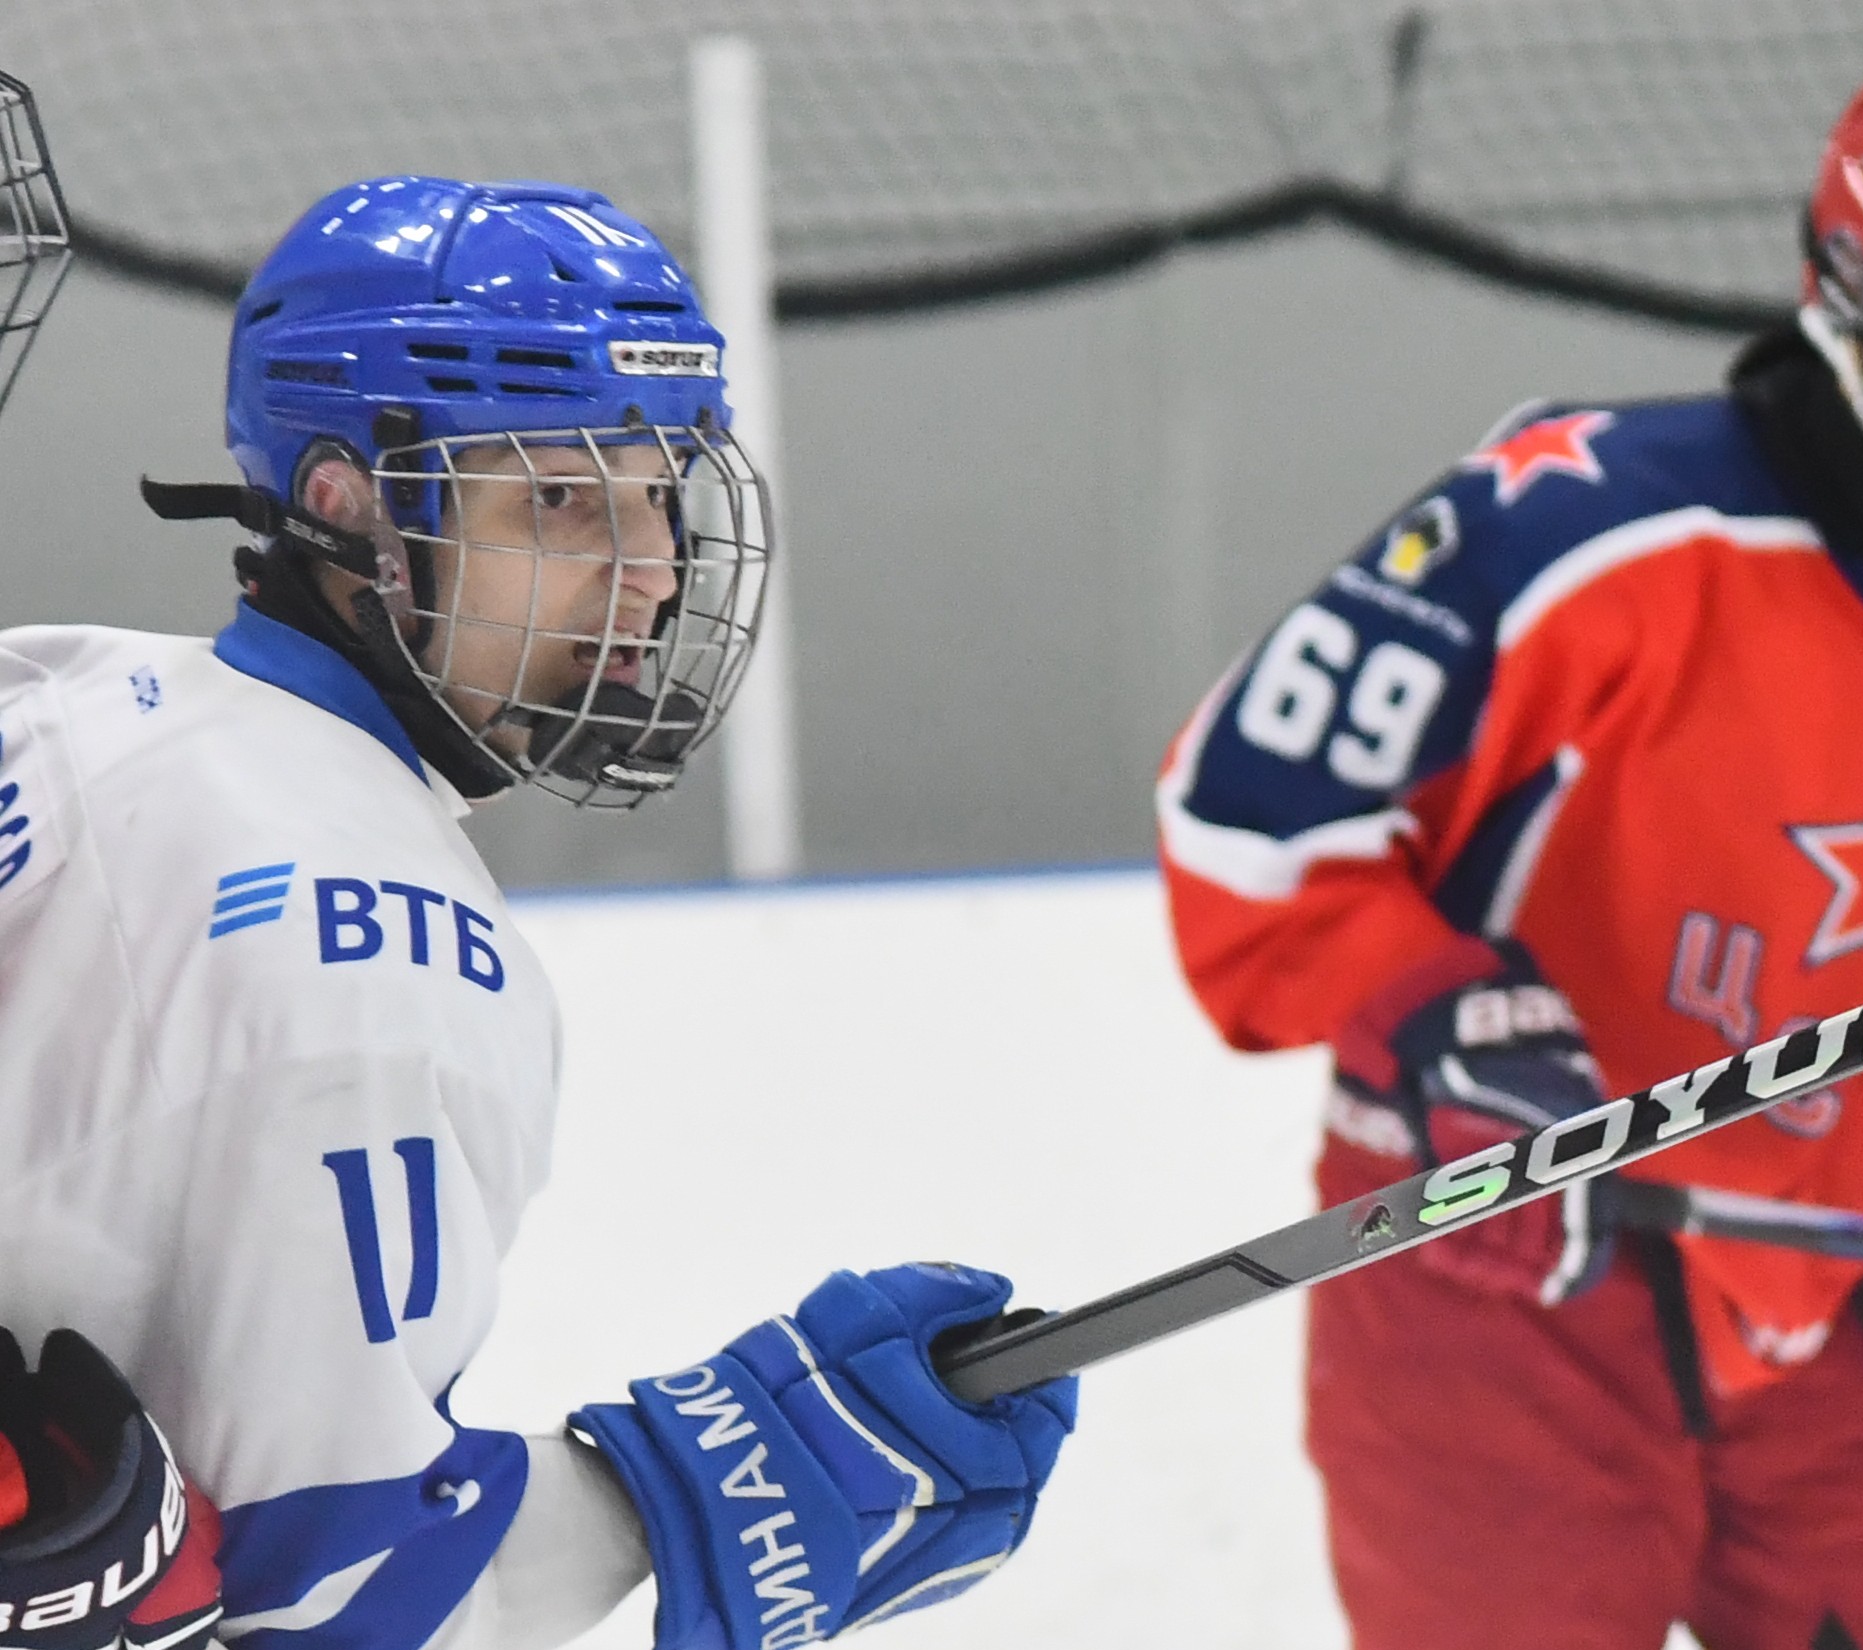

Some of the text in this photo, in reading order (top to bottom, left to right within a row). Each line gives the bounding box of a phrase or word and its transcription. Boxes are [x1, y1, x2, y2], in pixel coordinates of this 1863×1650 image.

[1237, 603, 1446, 788] 69
[314, 877, 505, 992] ВТБ
[321, 1137, 439, 1344] 11
